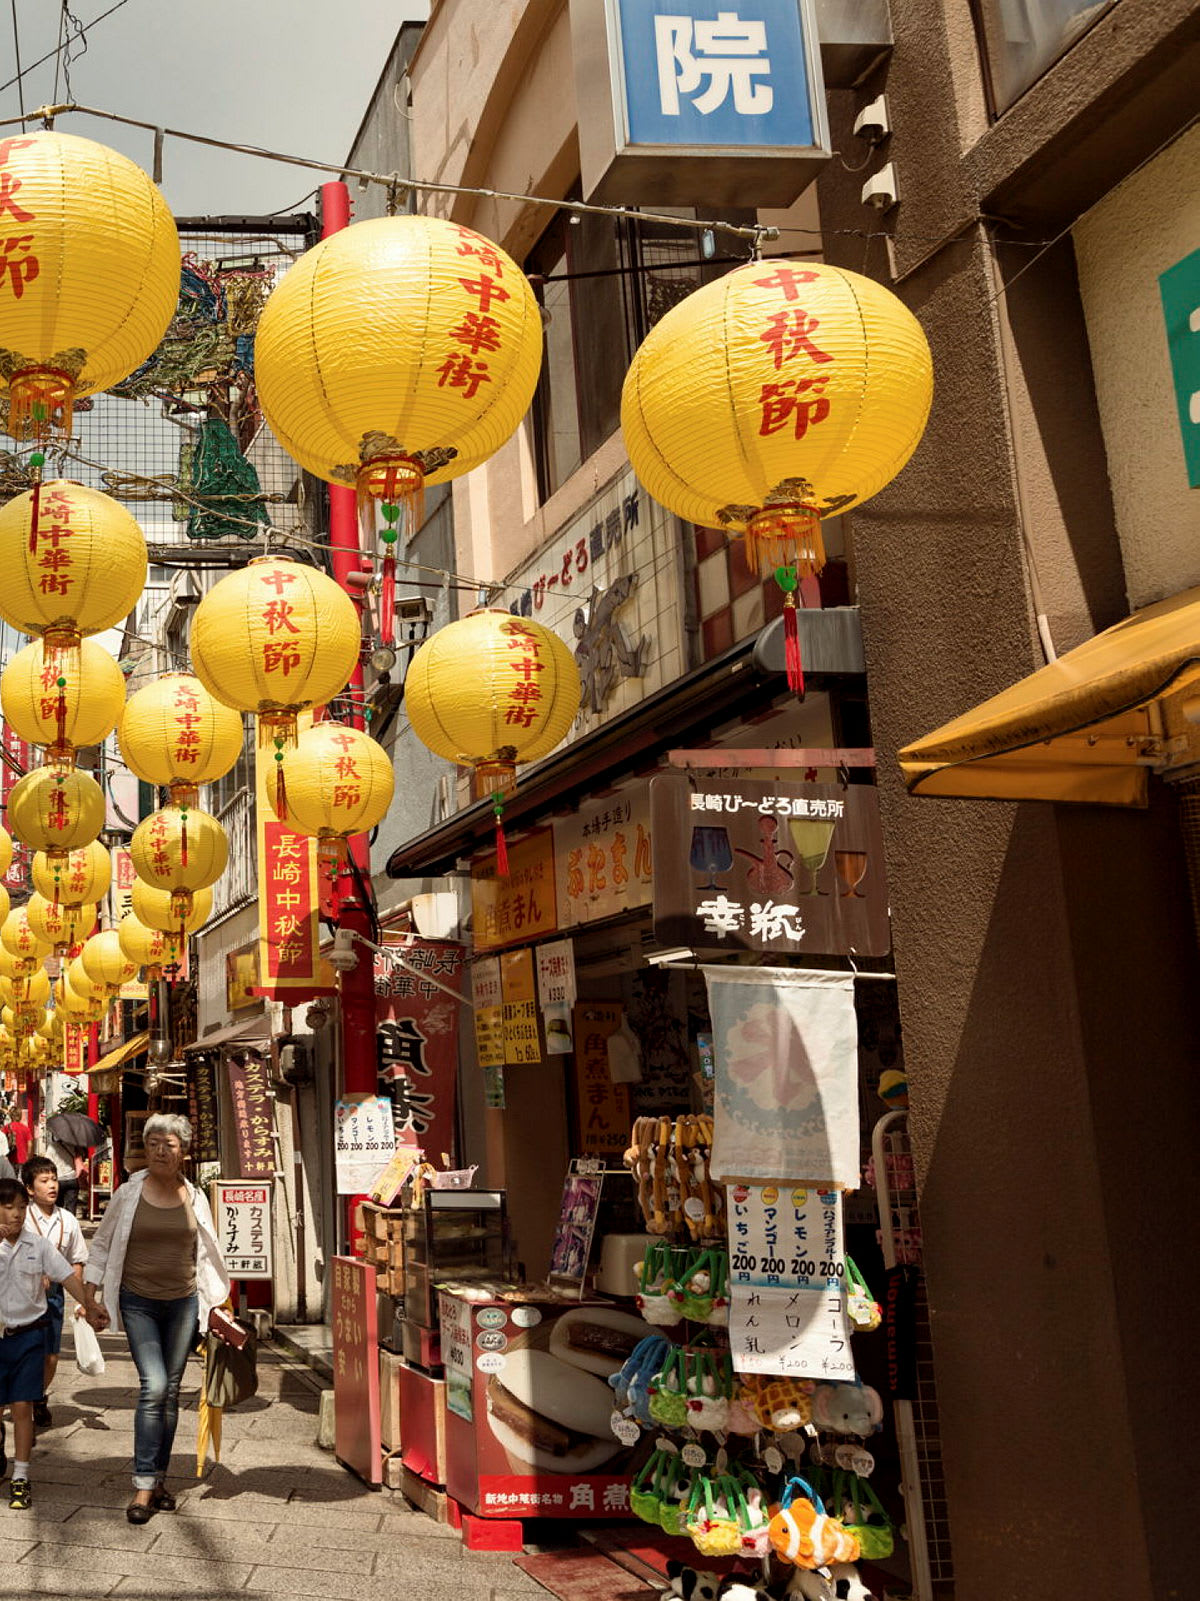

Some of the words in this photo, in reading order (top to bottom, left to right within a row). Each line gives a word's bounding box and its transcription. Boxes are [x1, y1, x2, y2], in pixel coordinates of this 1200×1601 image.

[654, 12, 774, 116] 院
[436, 224, 512, 400] 長崎中華街
[752, 267, 835, 441] 中秋節
[38, 489, 76, 597] 長崎中華街
[260, 570, 301, 678] 中秋節
[499, 621, 545, 729] 長崎中華街
[173, 685, 202, 765] 長崎中華街
[330, 733, 363, 811] 中秋節
[567, 823, 653, 898] ぶたまん
[45, 903, 63, 934] 秋節
[271, 834, 303, 966] 長崎中秋節
[226, 1206, 240, 1254] からすみ
[249, 1205, 264, 1254] カステラ
[735, 1204, 749, 1255] いちご
[763, 1207, 778, 1258] マンゴー
[794, 1208, 808, 1258] レモン
[334, 1262, 361, 1297] 自家製
[732, 1254, 757, 1271] 200
[738, 1271, 751, 1282] 円
[761, 1257, 786, 1274] 200
[767, 1274, 780, 1285] 円
[791, 1259, 816, 1276] 200
[797, 1275, 810, 1286] 円
[819, 1261, 845, 1278] 200
[826, 1277, 840, 1287] 円
[336, 1311, 363, 1347] うまい
[745, 1291, 766, 1354] れん乳
[785, 1292, 802, 1351] メロン
[828, 1298, 845, 1353] コーラ
[778, 1356, 809, 1370] ¥200
[821, 1358, 854, 1374] ¥200
[484, 1492, 564, 1507] 新地中華街名物
[568, 1482, 633, 1513] 角煮
